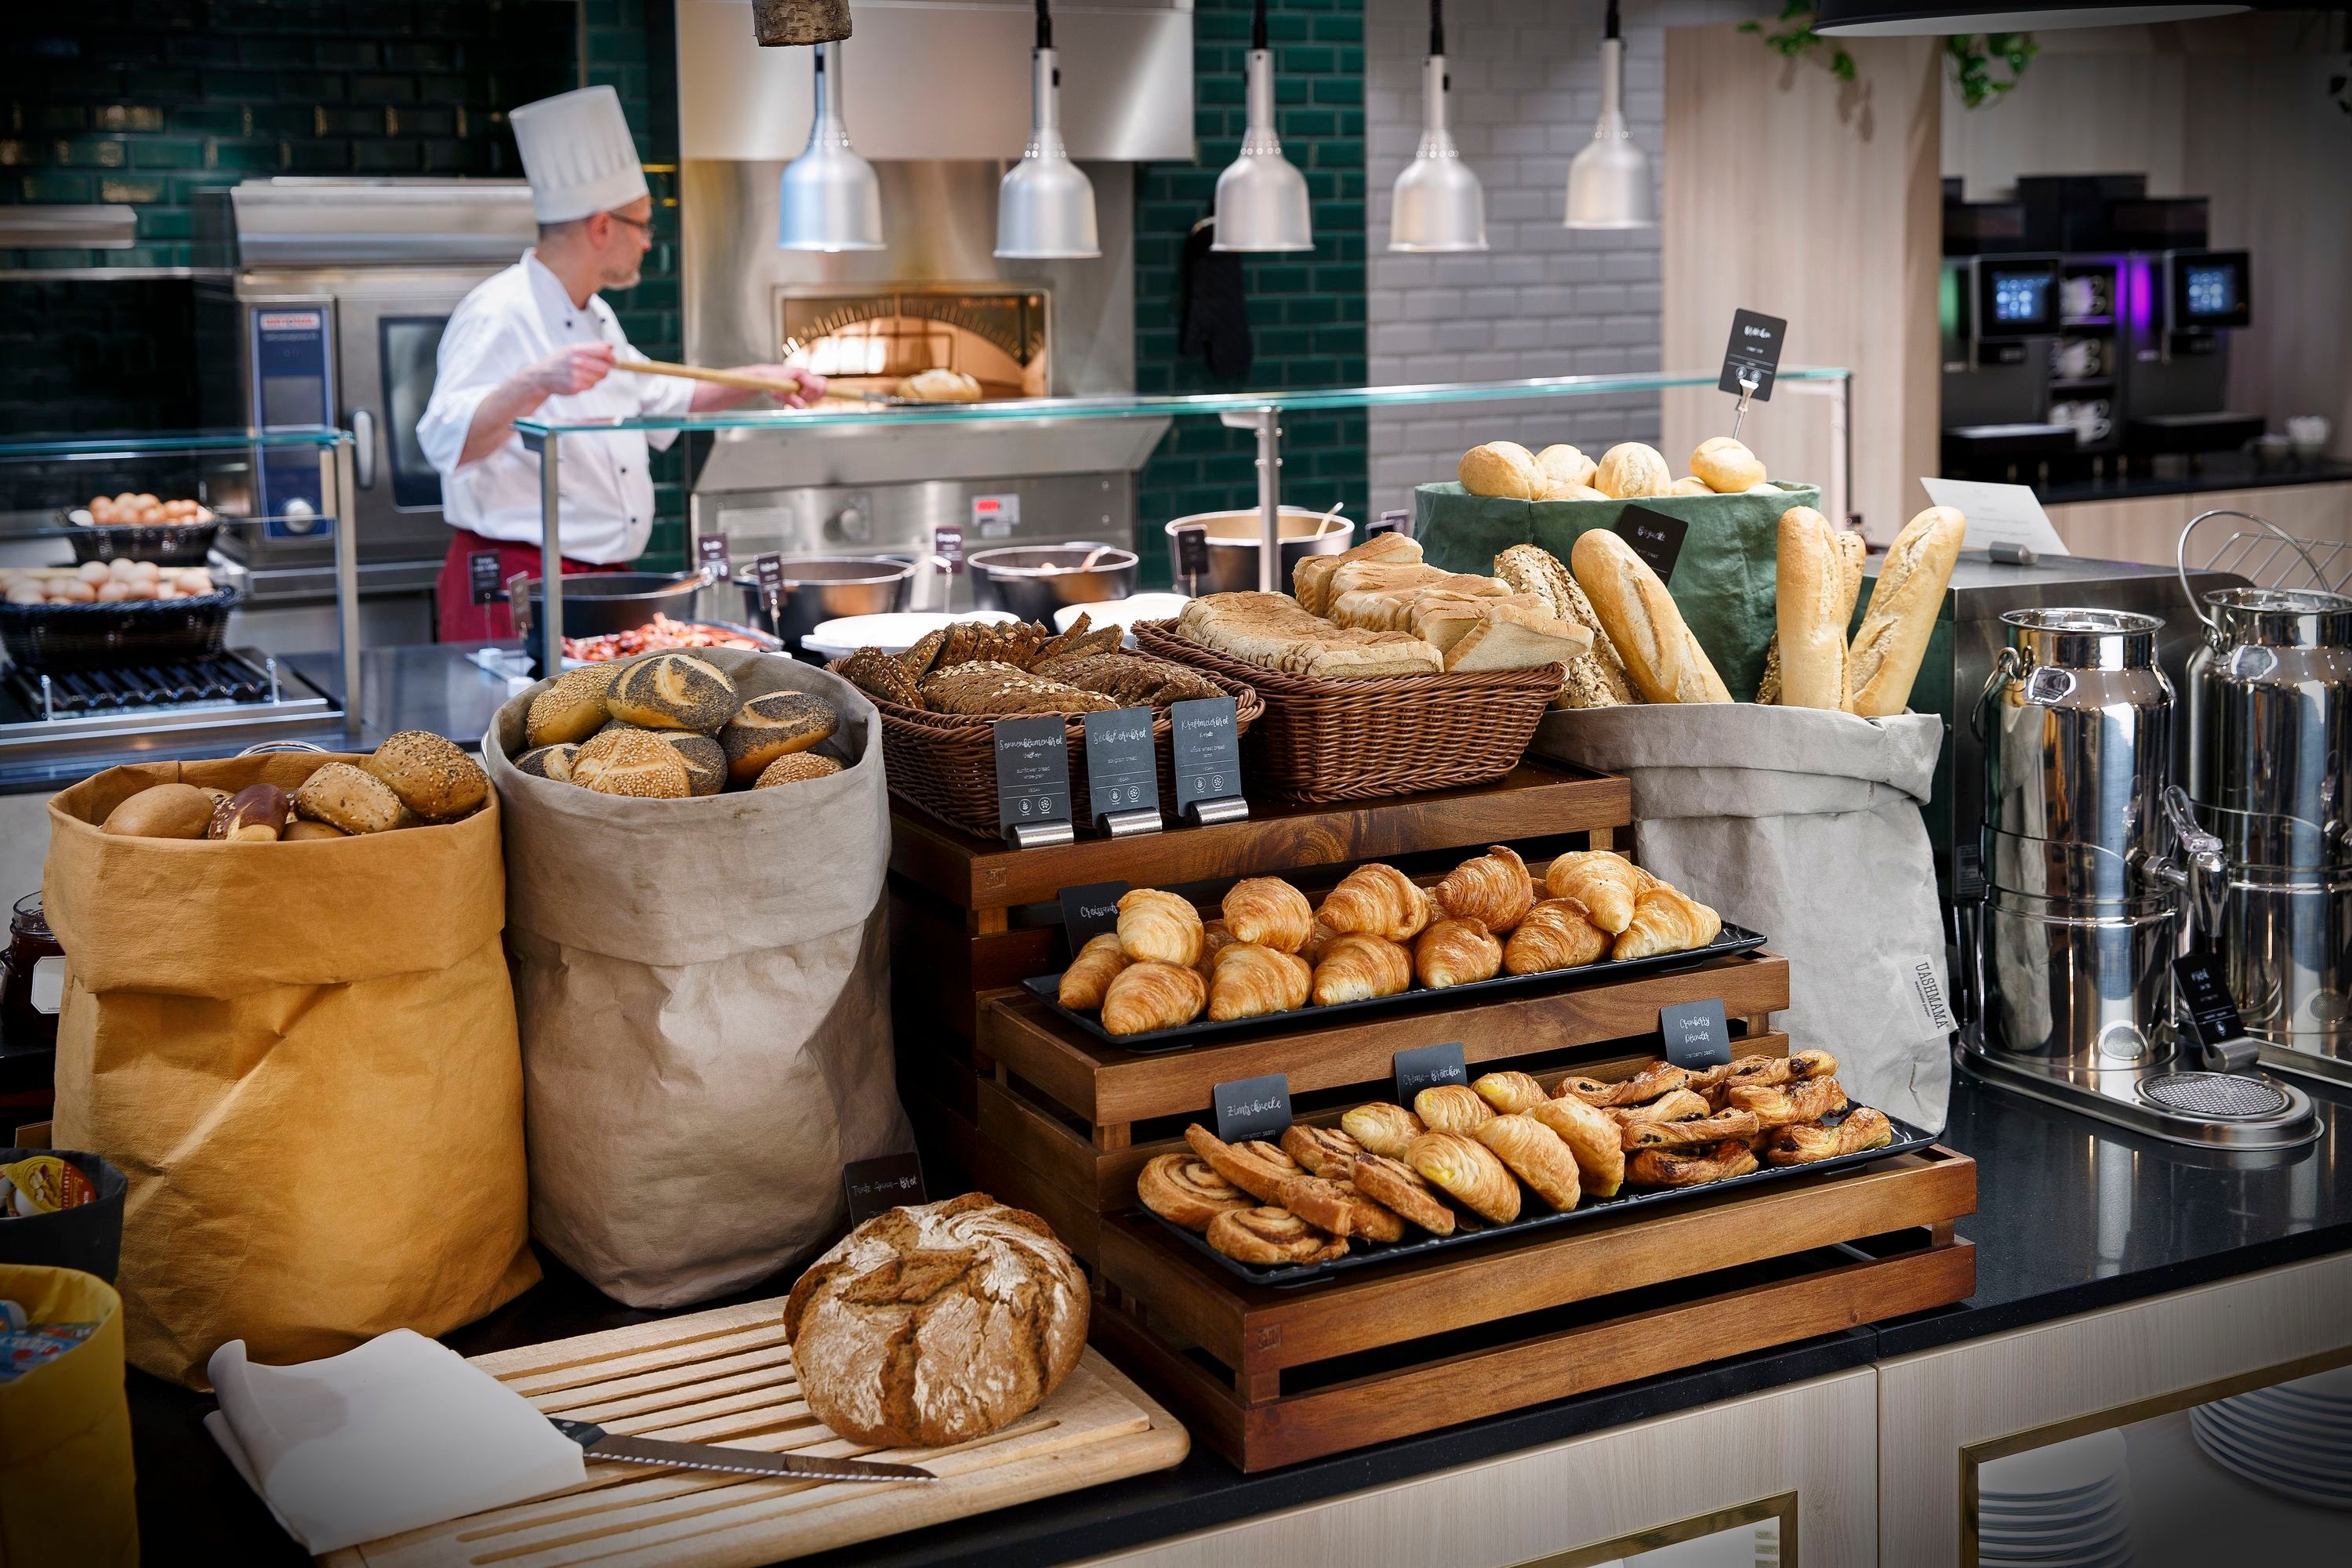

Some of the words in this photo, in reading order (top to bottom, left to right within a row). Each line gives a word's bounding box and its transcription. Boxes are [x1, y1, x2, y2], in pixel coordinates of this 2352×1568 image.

[1080, 902, 1118, 918] Croissants
[1915, 962, 1949, 1029] UASHMAMA
[1679, 1016, 1710, 1029] Cranberry
[1226, 1096, 1282, 1117] Zimtschnecke
